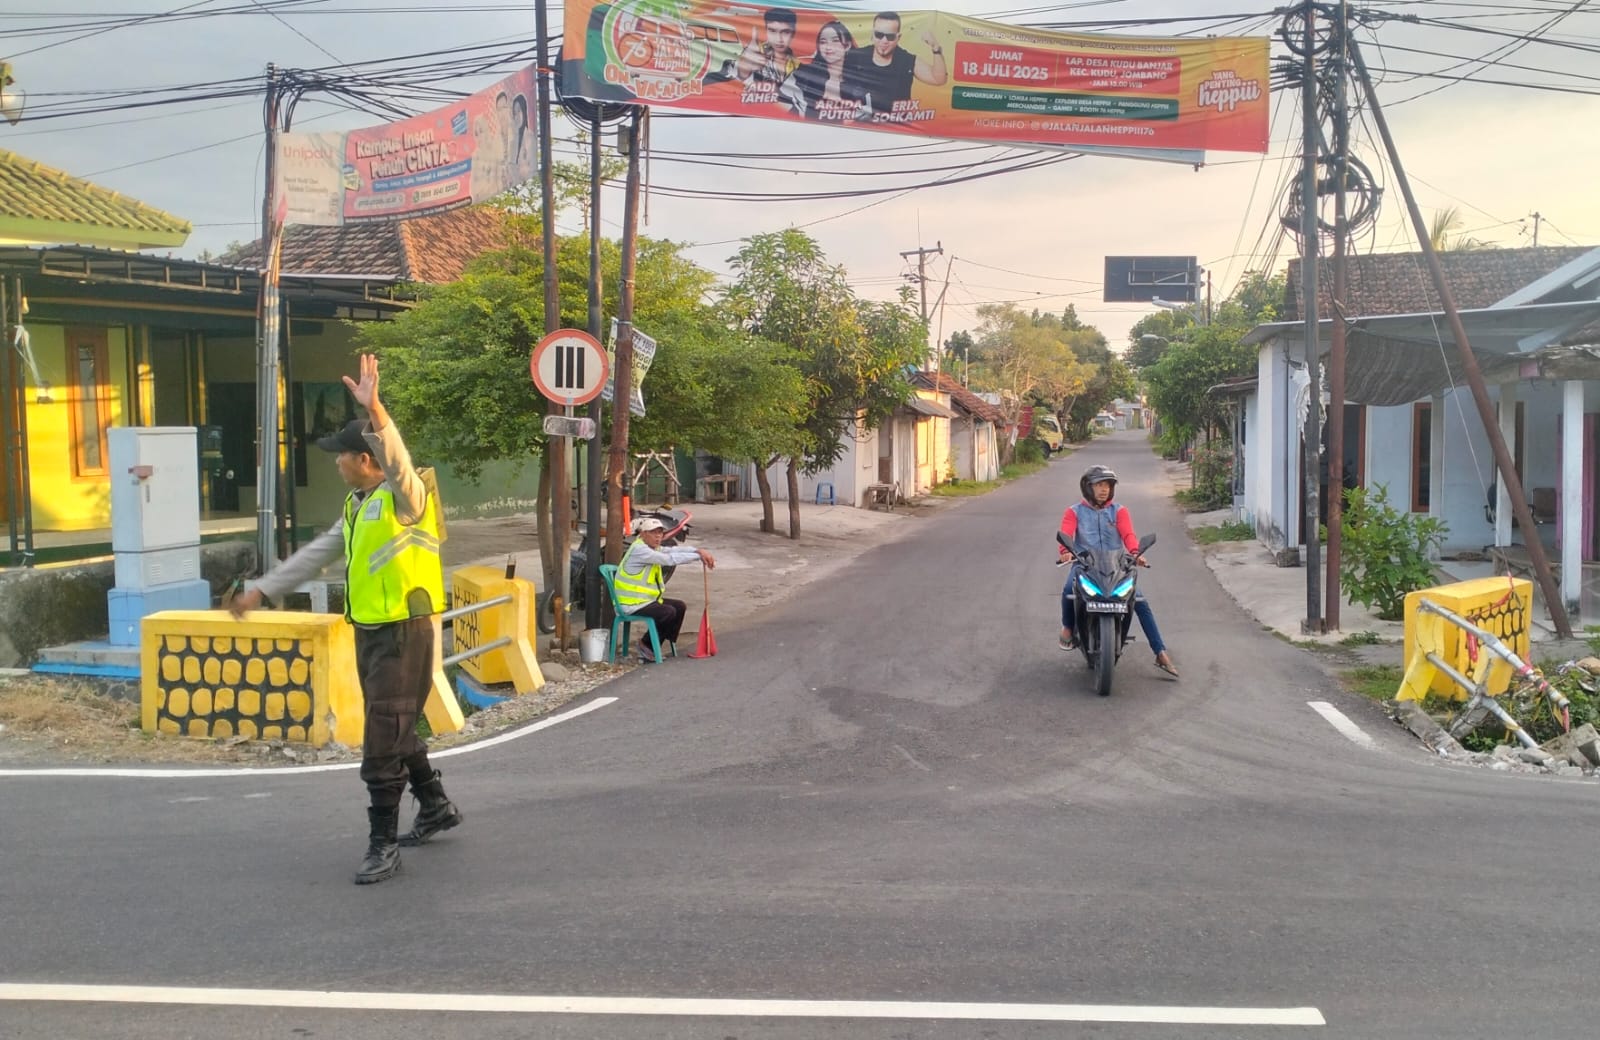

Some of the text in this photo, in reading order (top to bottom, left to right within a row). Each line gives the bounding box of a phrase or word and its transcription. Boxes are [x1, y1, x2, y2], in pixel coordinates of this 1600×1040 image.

[653, 44, 690, 57] JALAN
[989, 50, 1023, 61] JUMAT
[962, 61, 1049, 80] 18 JULI 2025
[1065, 57, 1173, 71] LAP. DESA KUDU BANJAR
[605, 64, 630, 84] ON
[1070, 67, 1088, 77] KEC.
[1120, 71, 1167, 80] JOMBANG
[1213, 72, 1234, 80] YANG
[635, 79, 703, 97] VACATION
[748, 83, 776, 93] ALDI
[1203, 79, 1241, 89] PENTING
[741, 93, 779, 103] TAHER
[892, 101, 919, 112] ERIX
[819, 110, 855, 120] PUTRI
[872, 110, 935, 123] SOEKAMTI
[974, 119, 1000, 128] MORE
[402, 128, 434, 151] Insan
[405, 143, 449, 173] CINTA
